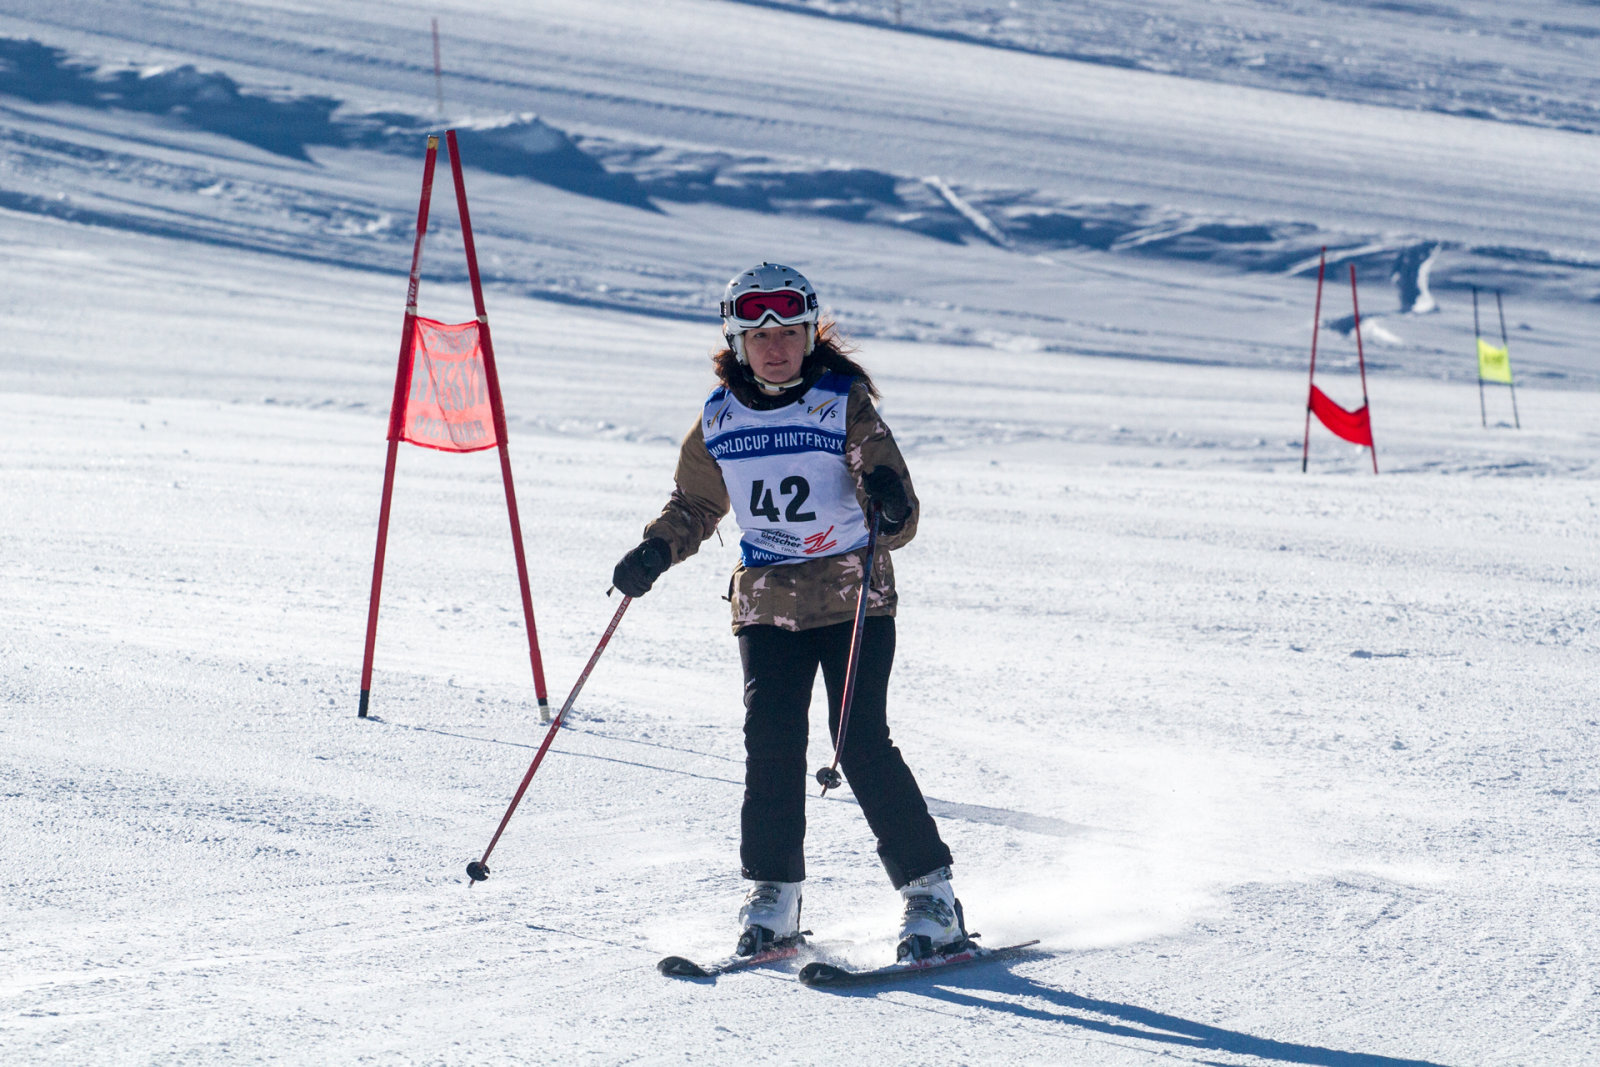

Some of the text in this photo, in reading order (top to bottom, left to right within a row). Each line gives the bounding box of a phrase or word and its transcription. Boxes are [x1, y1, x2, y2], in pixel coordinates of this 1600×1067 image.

[709, 432, 844, 459] WORLDCUP HINTERTUX
[749, 475, 817, 523] 42
